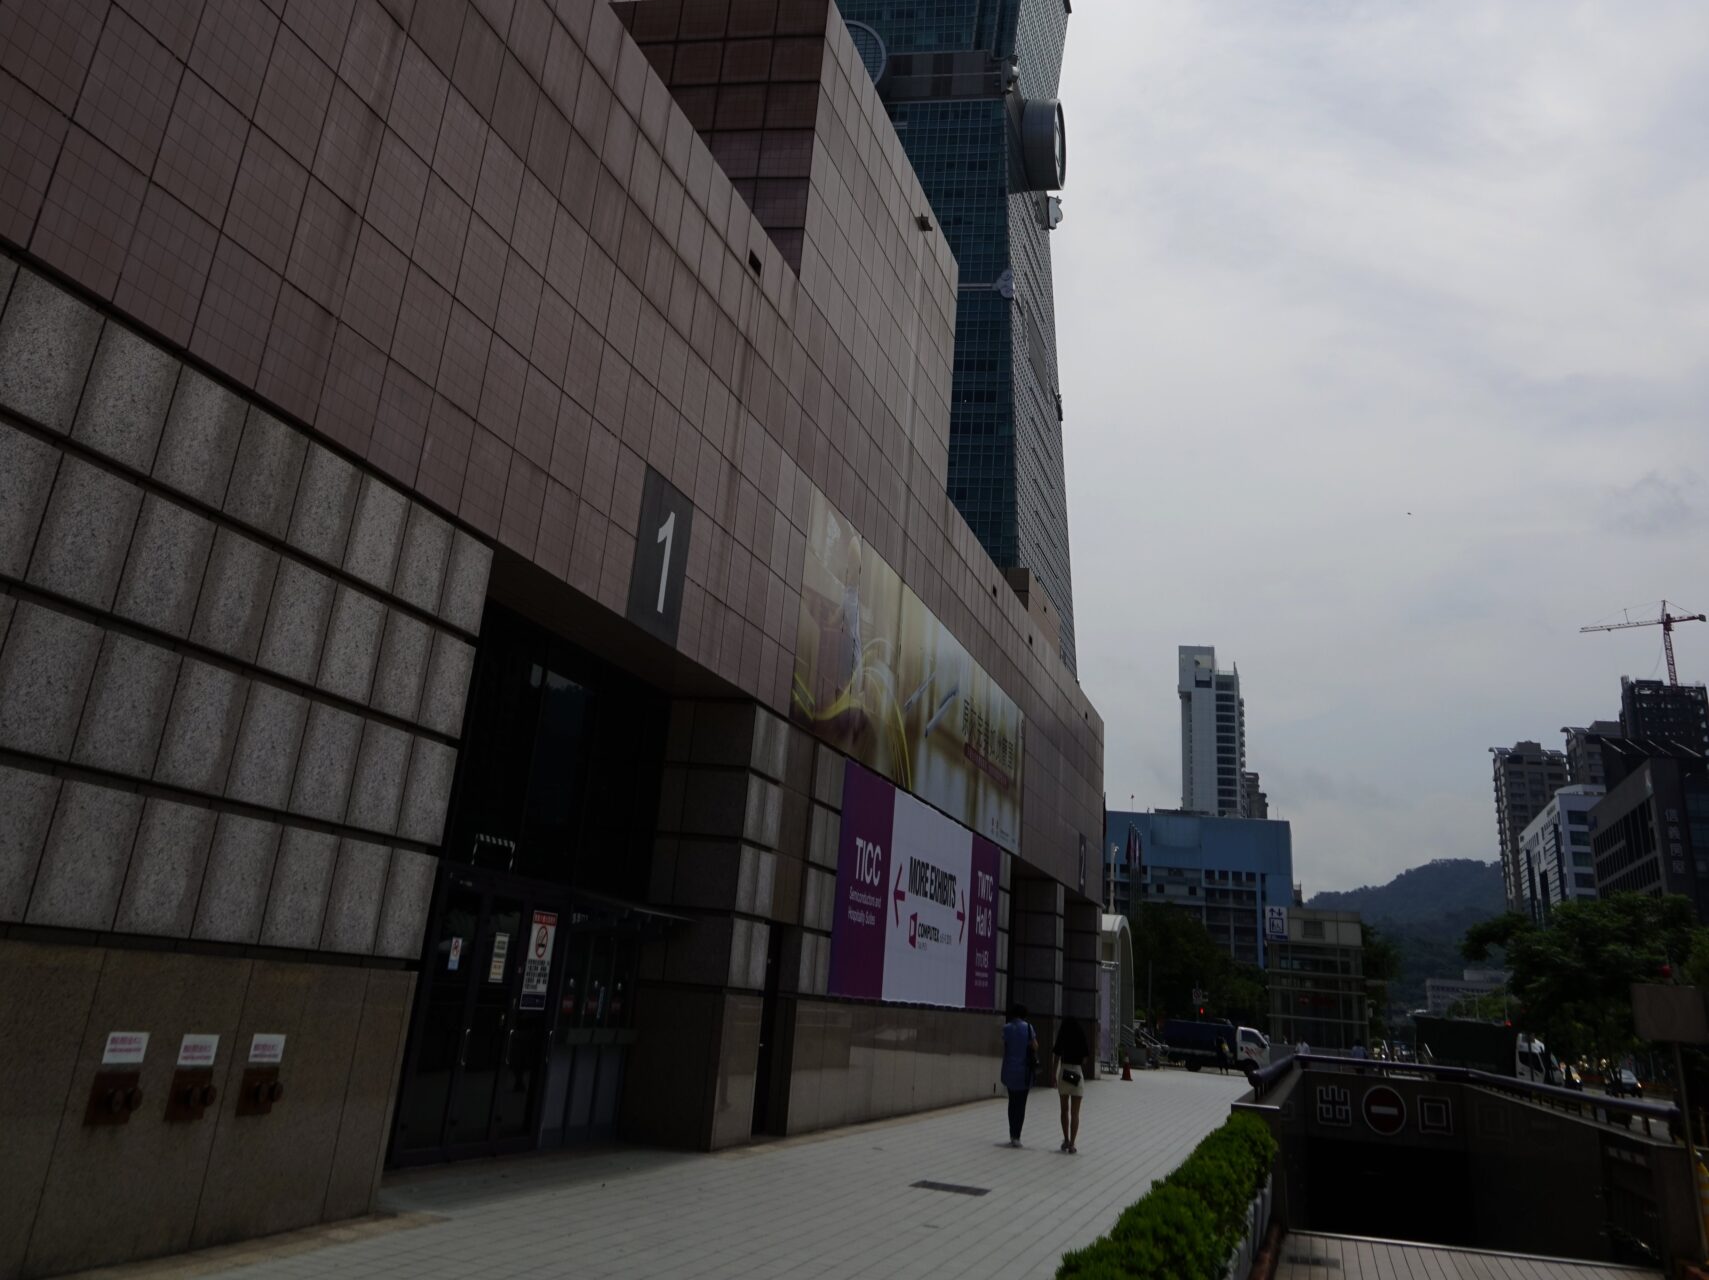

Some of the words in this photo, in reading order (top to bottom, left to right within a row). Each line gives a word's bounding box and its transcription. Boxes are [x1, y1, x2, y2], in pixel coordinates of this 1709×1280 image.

[656, 511, 675, 613] 1
[855, 836, 881, 887] TICC
[908, 856, 930, 898] MORE
[929, 864, 956, 909] EXHIBITS
[977, 869, 994, 903] TWTC
[917, 923, 940, 943] COMPUTEX
[975, 904, 987, 937] Hall
[1317, 1085, 1352, 1127] 出
